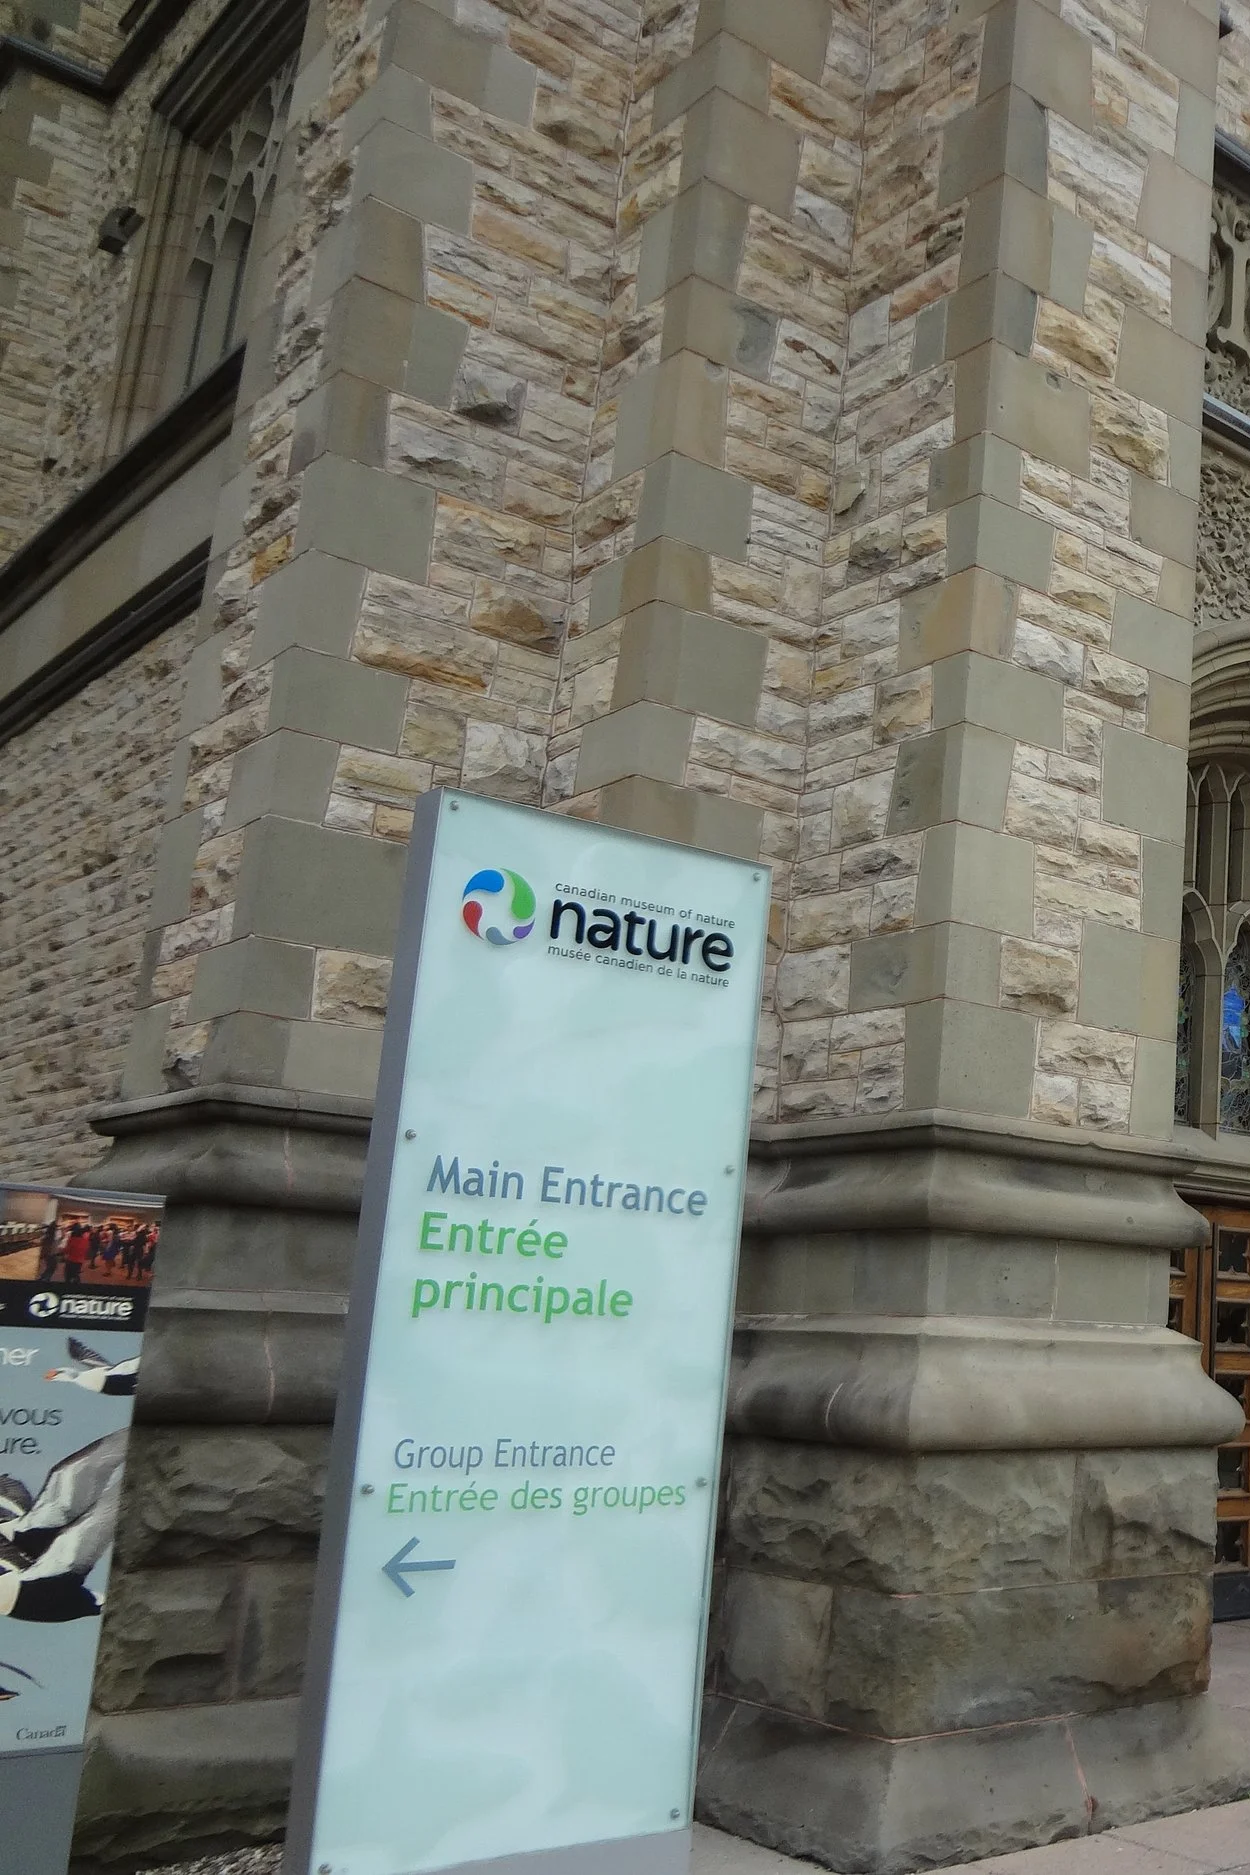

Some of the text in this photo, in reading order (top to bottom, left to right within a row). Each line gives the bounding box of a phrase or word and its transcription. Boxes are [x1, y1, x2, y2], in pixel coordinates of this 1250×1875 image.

[555, 880, 736, 930] canadian museum of nature
[549, 898, 735, 972] nature
[548, 944, 730, 988] musée canadien de la nature
[426, 1154, 709, 1217] Main Entrance
[418, 1210, 569, 1259] Entrée
[60, 1298, 134, 1317] nature
[411, 1271, 634, 1324] principale
[394, 1438, 616, 1476] Group Entrance
[386, 1479, 687, 1517] Entrée des groupes
[15, 1724, 67, 1741] Canada
